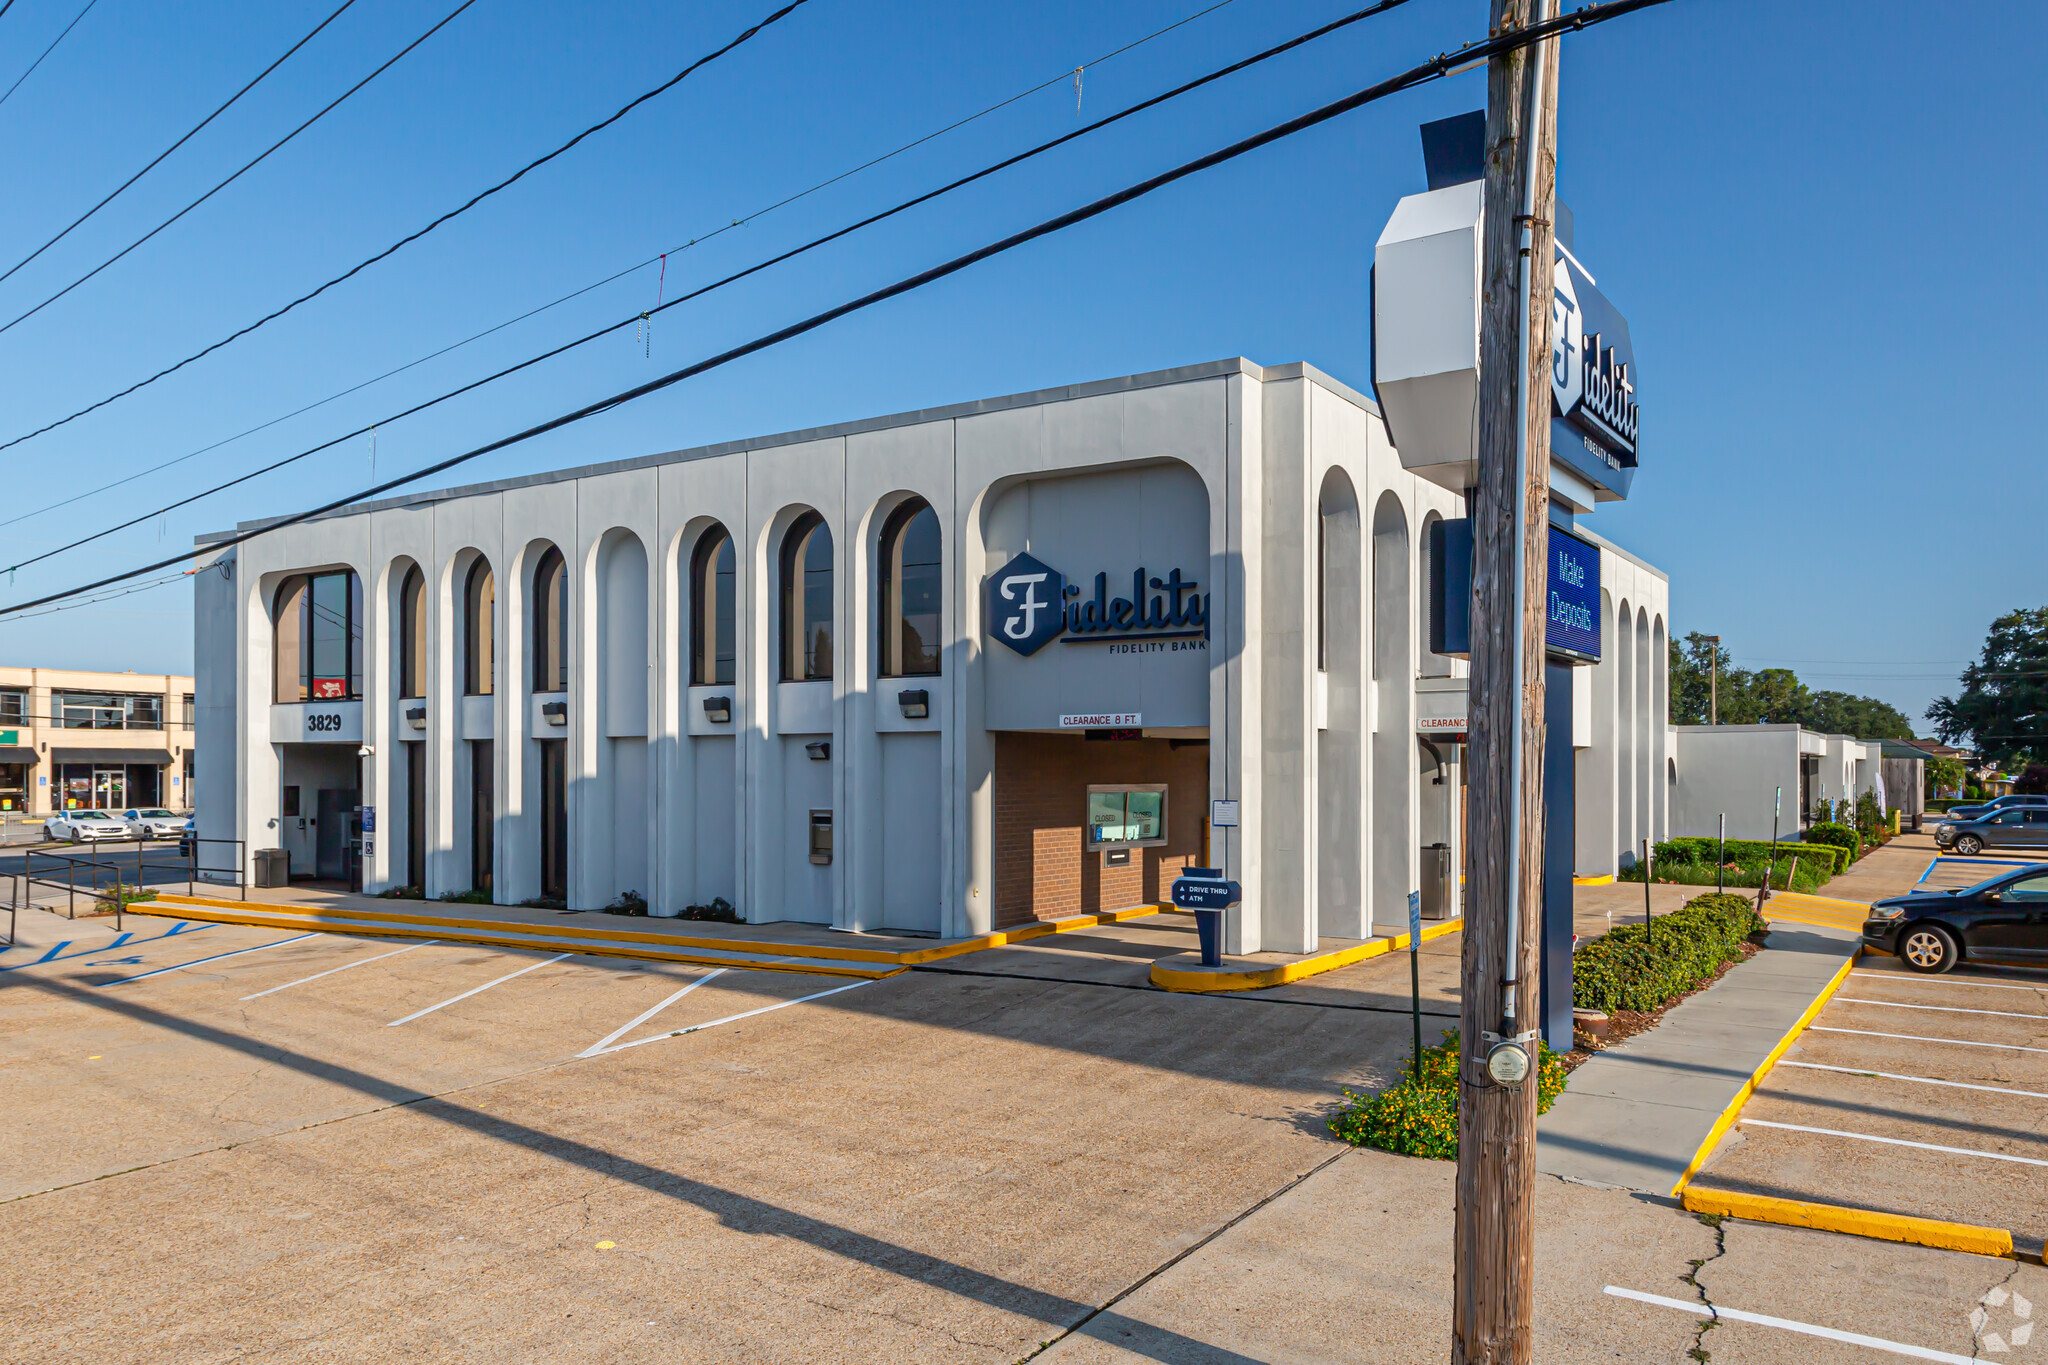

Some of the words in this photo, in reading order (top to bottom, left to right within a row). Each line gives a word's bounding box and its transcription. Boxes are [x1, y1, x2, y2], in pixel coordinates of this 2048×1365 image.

[1584, 436, 1606, 462] FIDELITY
[1608, 453, 1620, 472] BANK
[1560, 551, 1584, 588] Make
[1552, 591, 1591, 631] Deposits
[1109, 642, 1165, 654] FIDELITY
[1172, 641, 1206, 652] BANK
[308, 714, 342, 731] 3829
[1063, 716, 1111, 725] CLEARANCE
[1115, 715, 1121, 725] 8
[1125, 715, 1137, 724] FT.
[1095, 814, 1115, 822] CLOSED
[1210, 887, 1228, 895] THRU
